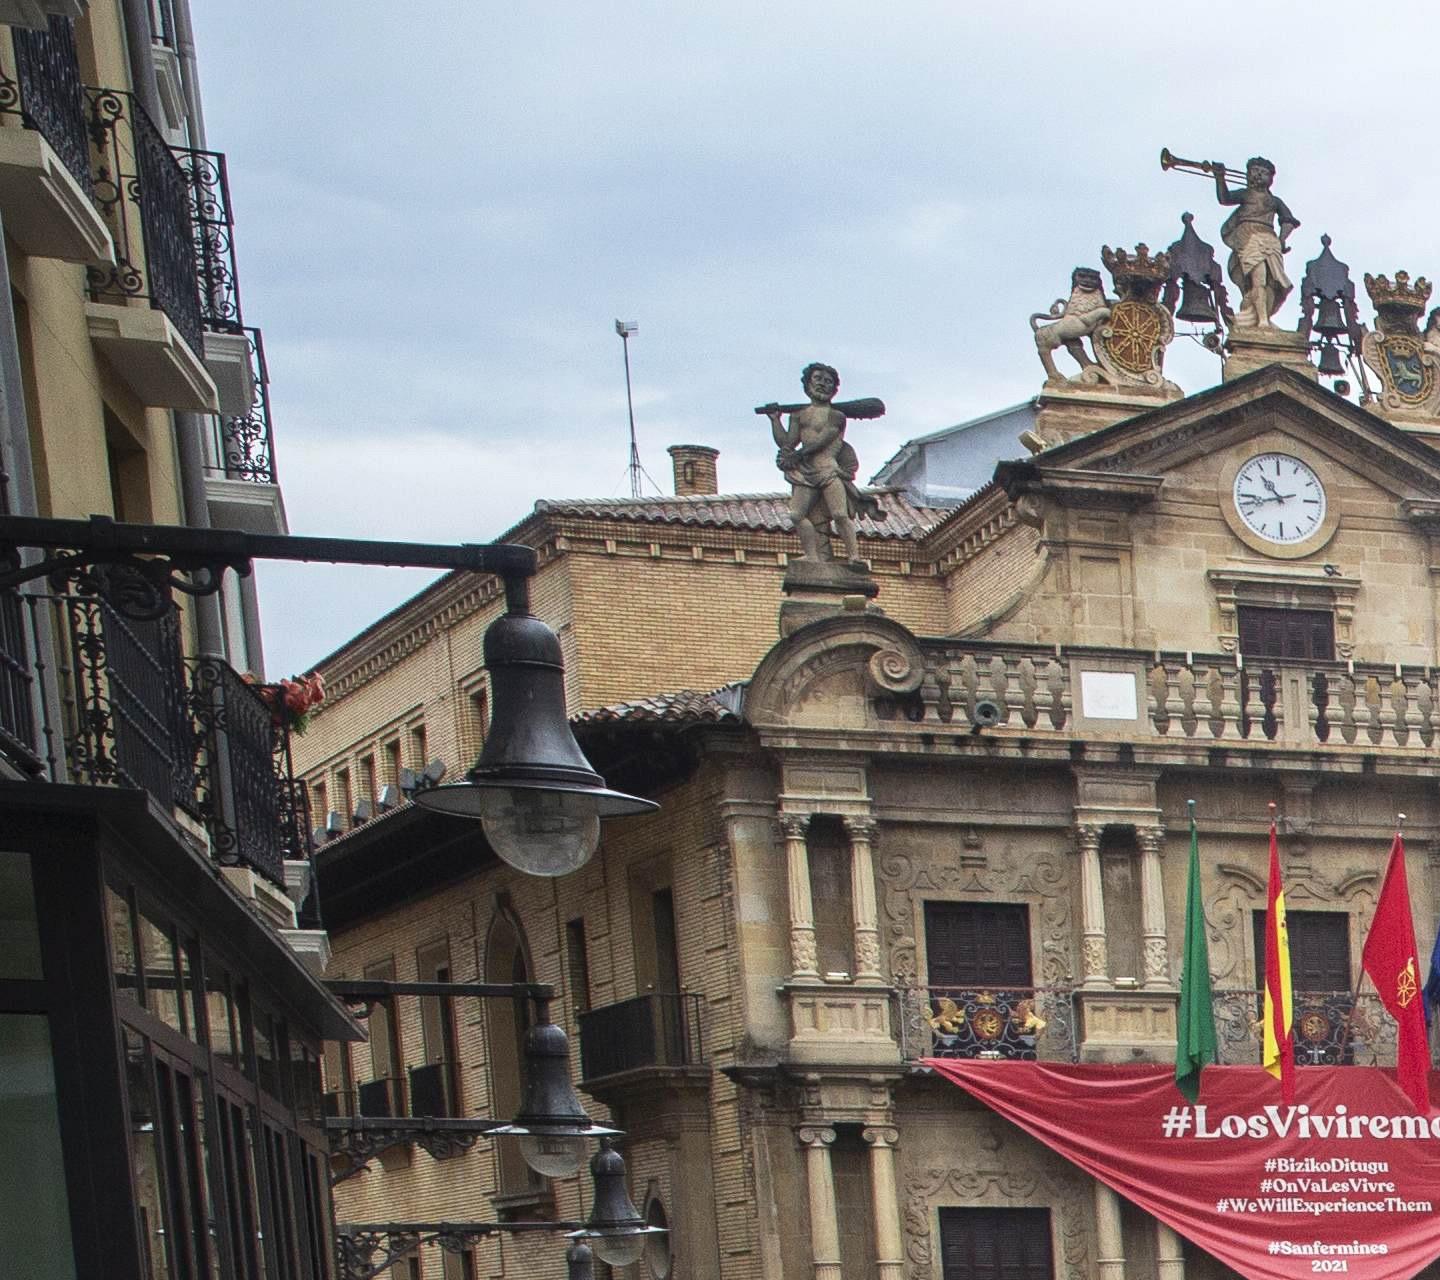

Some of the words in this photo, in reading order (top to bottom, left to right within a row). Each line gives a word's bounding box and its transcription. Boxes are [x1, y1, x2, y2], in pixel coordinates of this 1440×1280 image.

[1264, 1158, 1389, 1174] #BizikoDitugu
[1260, 1179, 1395, 1194] #OnVaLesVivre
[1216, 1197, 1432, 1215] #WeWillExperienceThem
[1268, 1241, 1388, 1255] #Sanfermines
[1311, 1260, 1348, 1273] 2021
